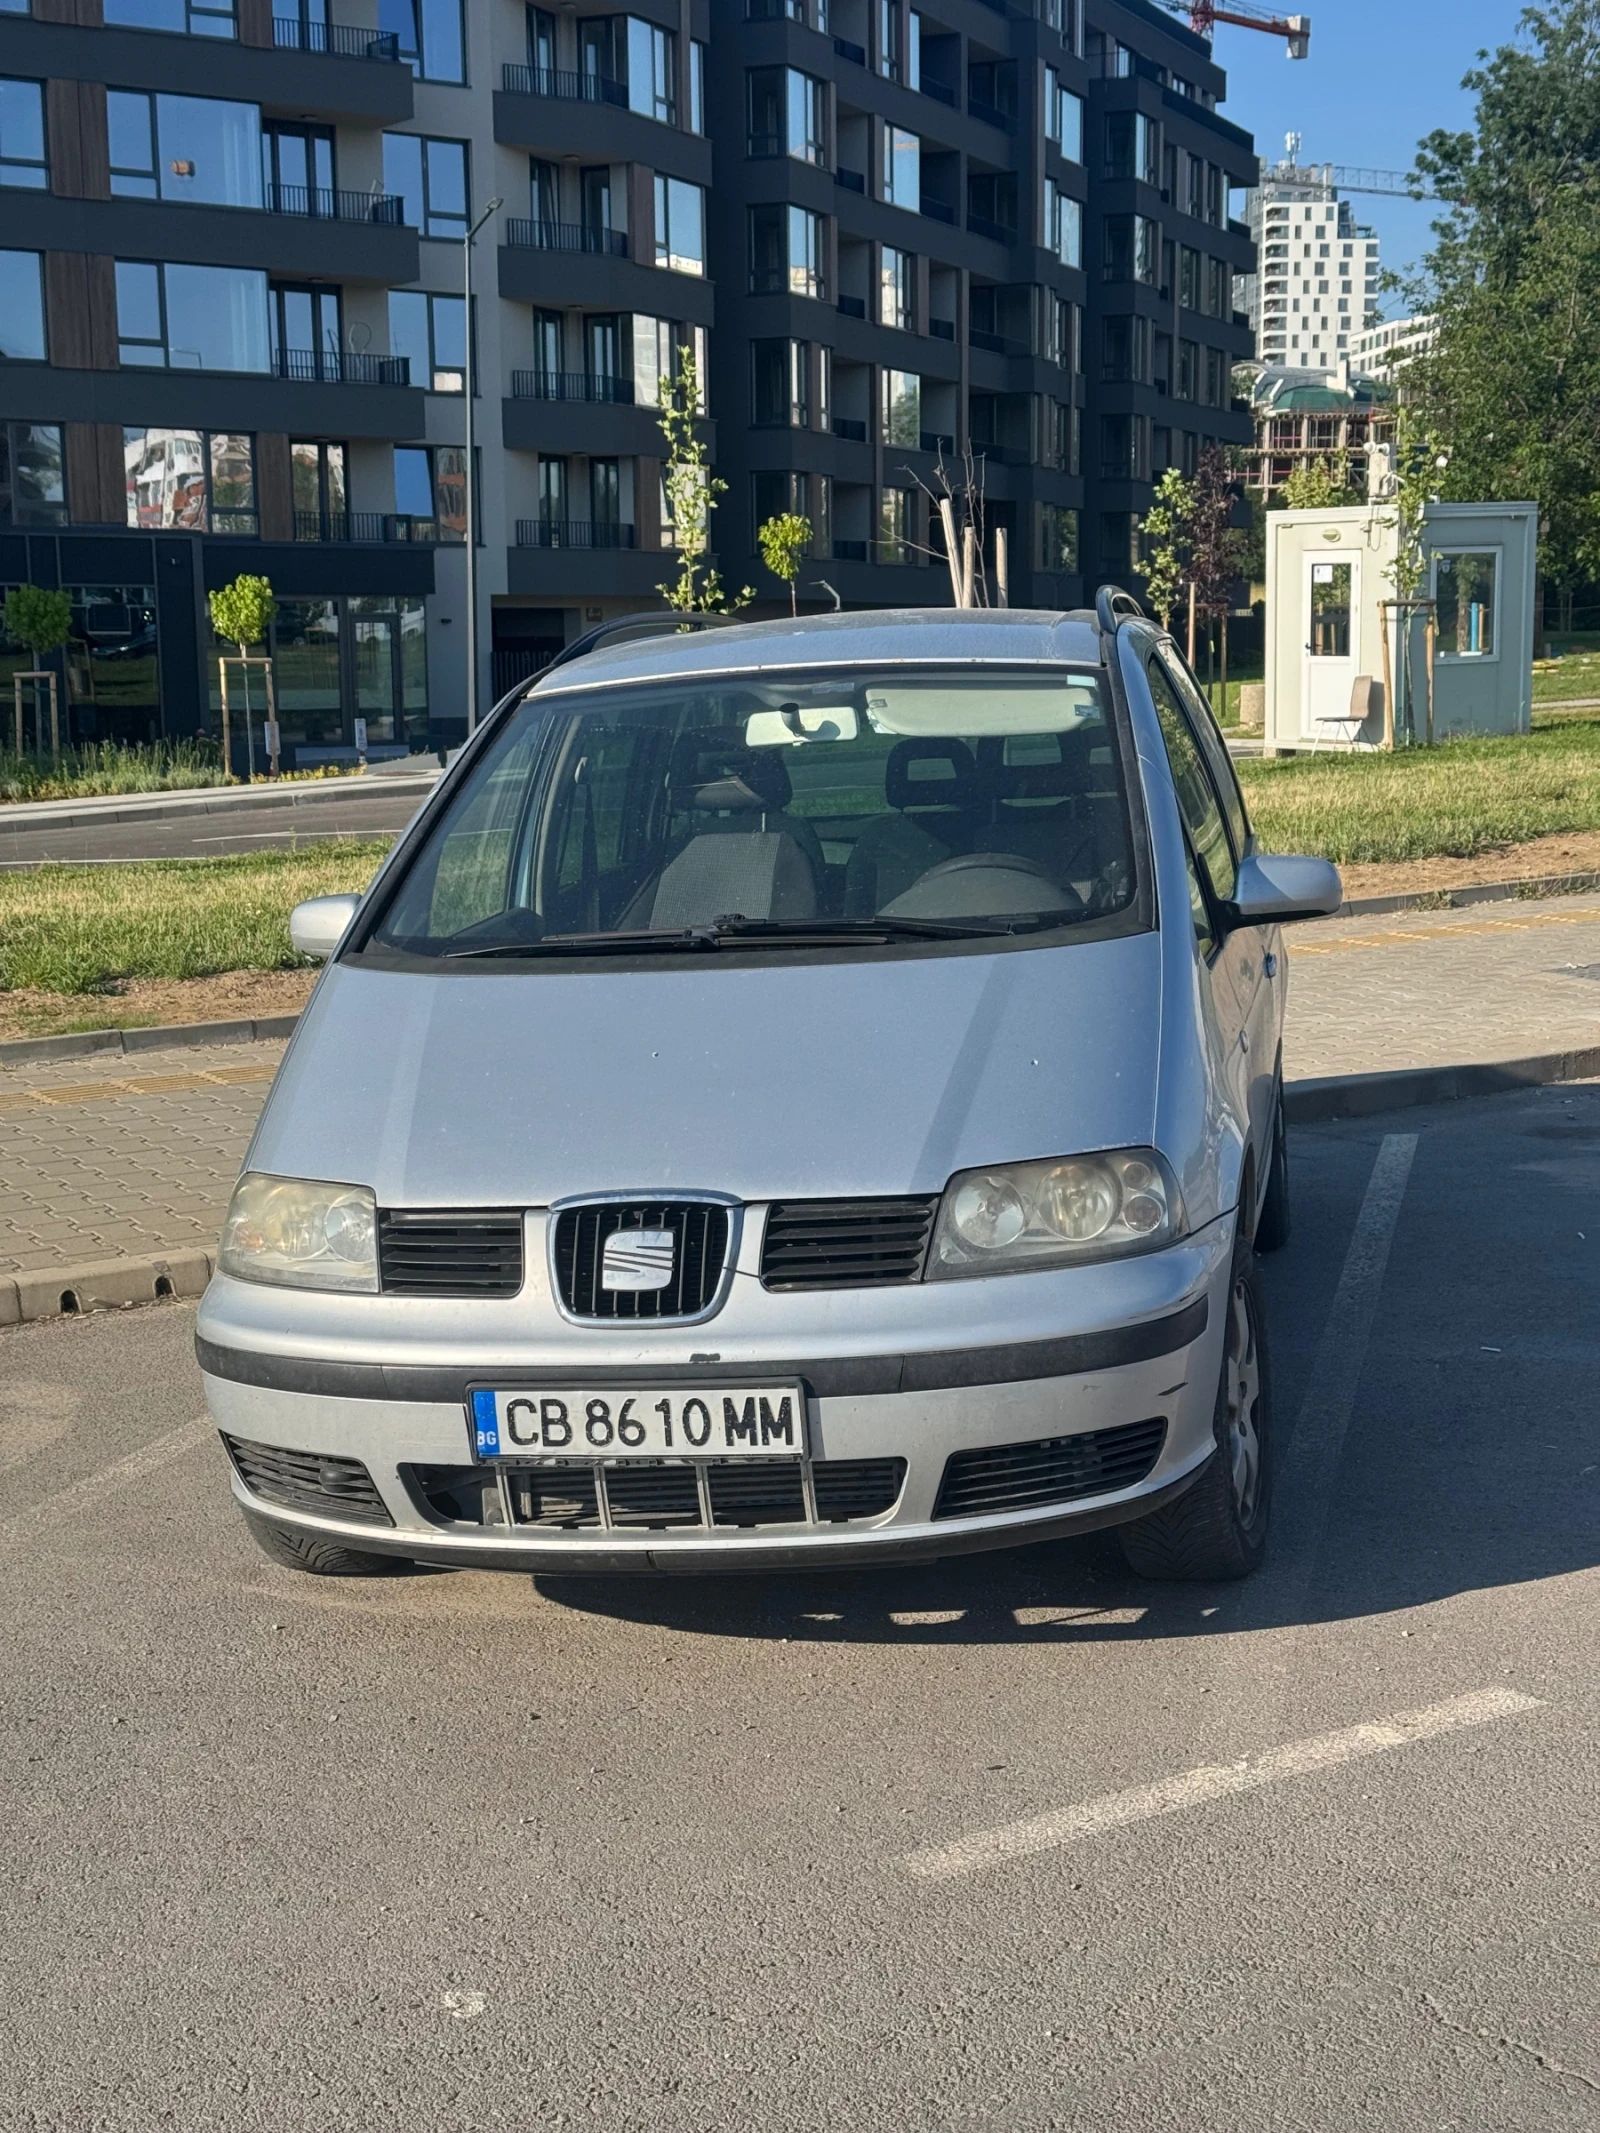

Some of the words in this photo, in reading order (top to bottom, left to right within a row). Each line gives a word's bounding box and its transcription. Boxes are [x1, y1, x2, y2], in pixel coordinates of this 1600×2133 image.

[506, 1398, 573, 1447] CB
[585, 1398, 711, 1447] 8610
[722, 1397, 794, 1446] MM
[477, 1431, 496, 1446] BG
